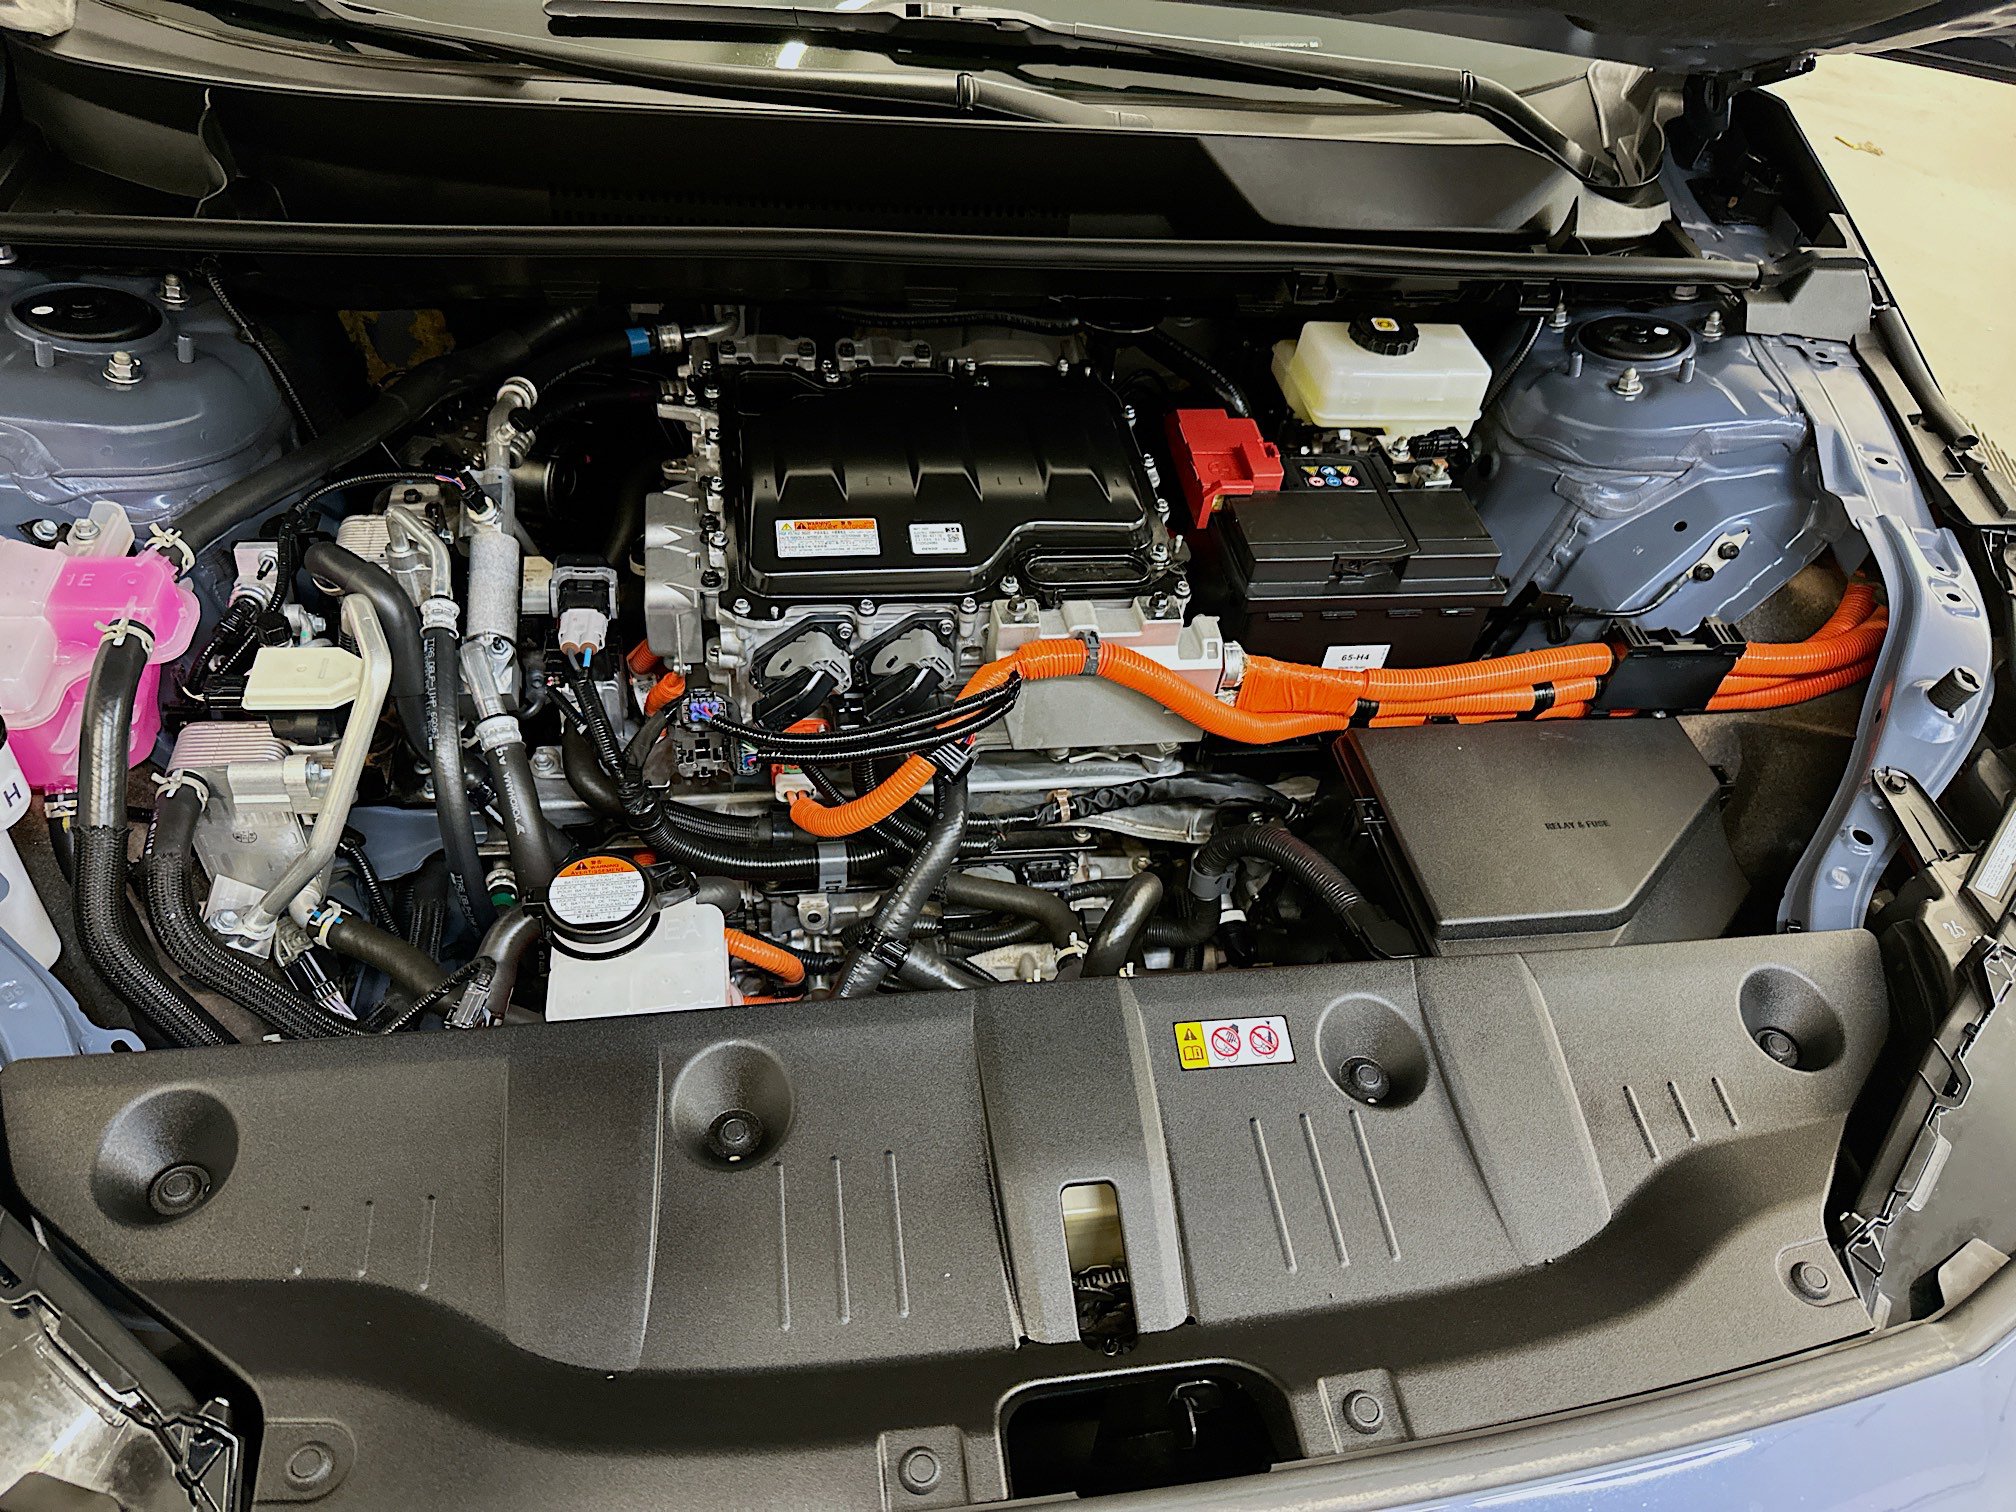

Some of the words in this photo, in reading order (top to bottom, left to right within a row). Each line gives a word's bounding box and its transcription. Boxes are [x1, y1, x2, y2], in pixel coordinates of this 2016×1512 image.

[1341, 654, 1370, 662] 65-H4
[503, 771, 522, 822] YOKOHAMA
[1544, 821, 1576, 831] RELAY
[1577, 820, 1586, 830] &
[1586, 819, 1612, 829] FUSE
